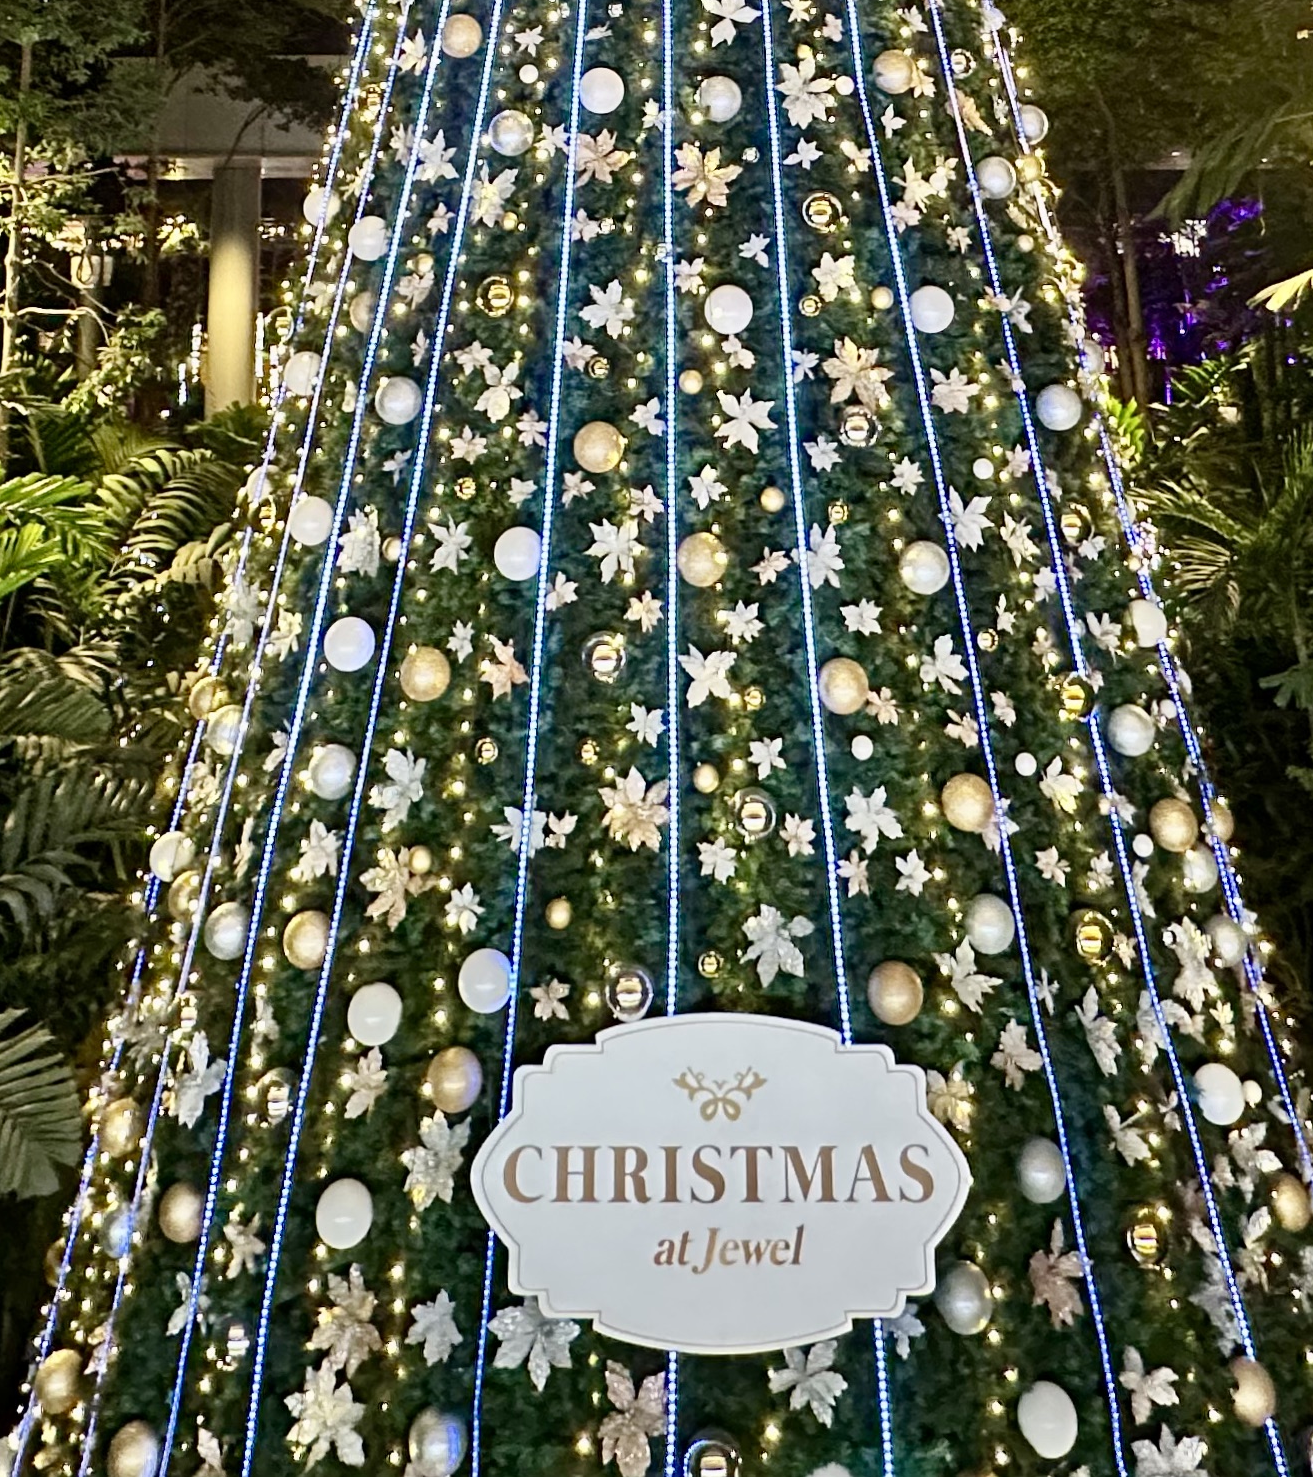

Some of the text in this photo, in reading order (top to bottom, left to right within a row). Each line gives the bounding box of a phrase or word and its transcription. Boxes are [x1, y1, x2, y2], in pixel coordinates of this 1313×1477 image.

[502, 1143, 935, 1204] CHRISTMAS
[653, 1224, 805, 1275] at Jewel
